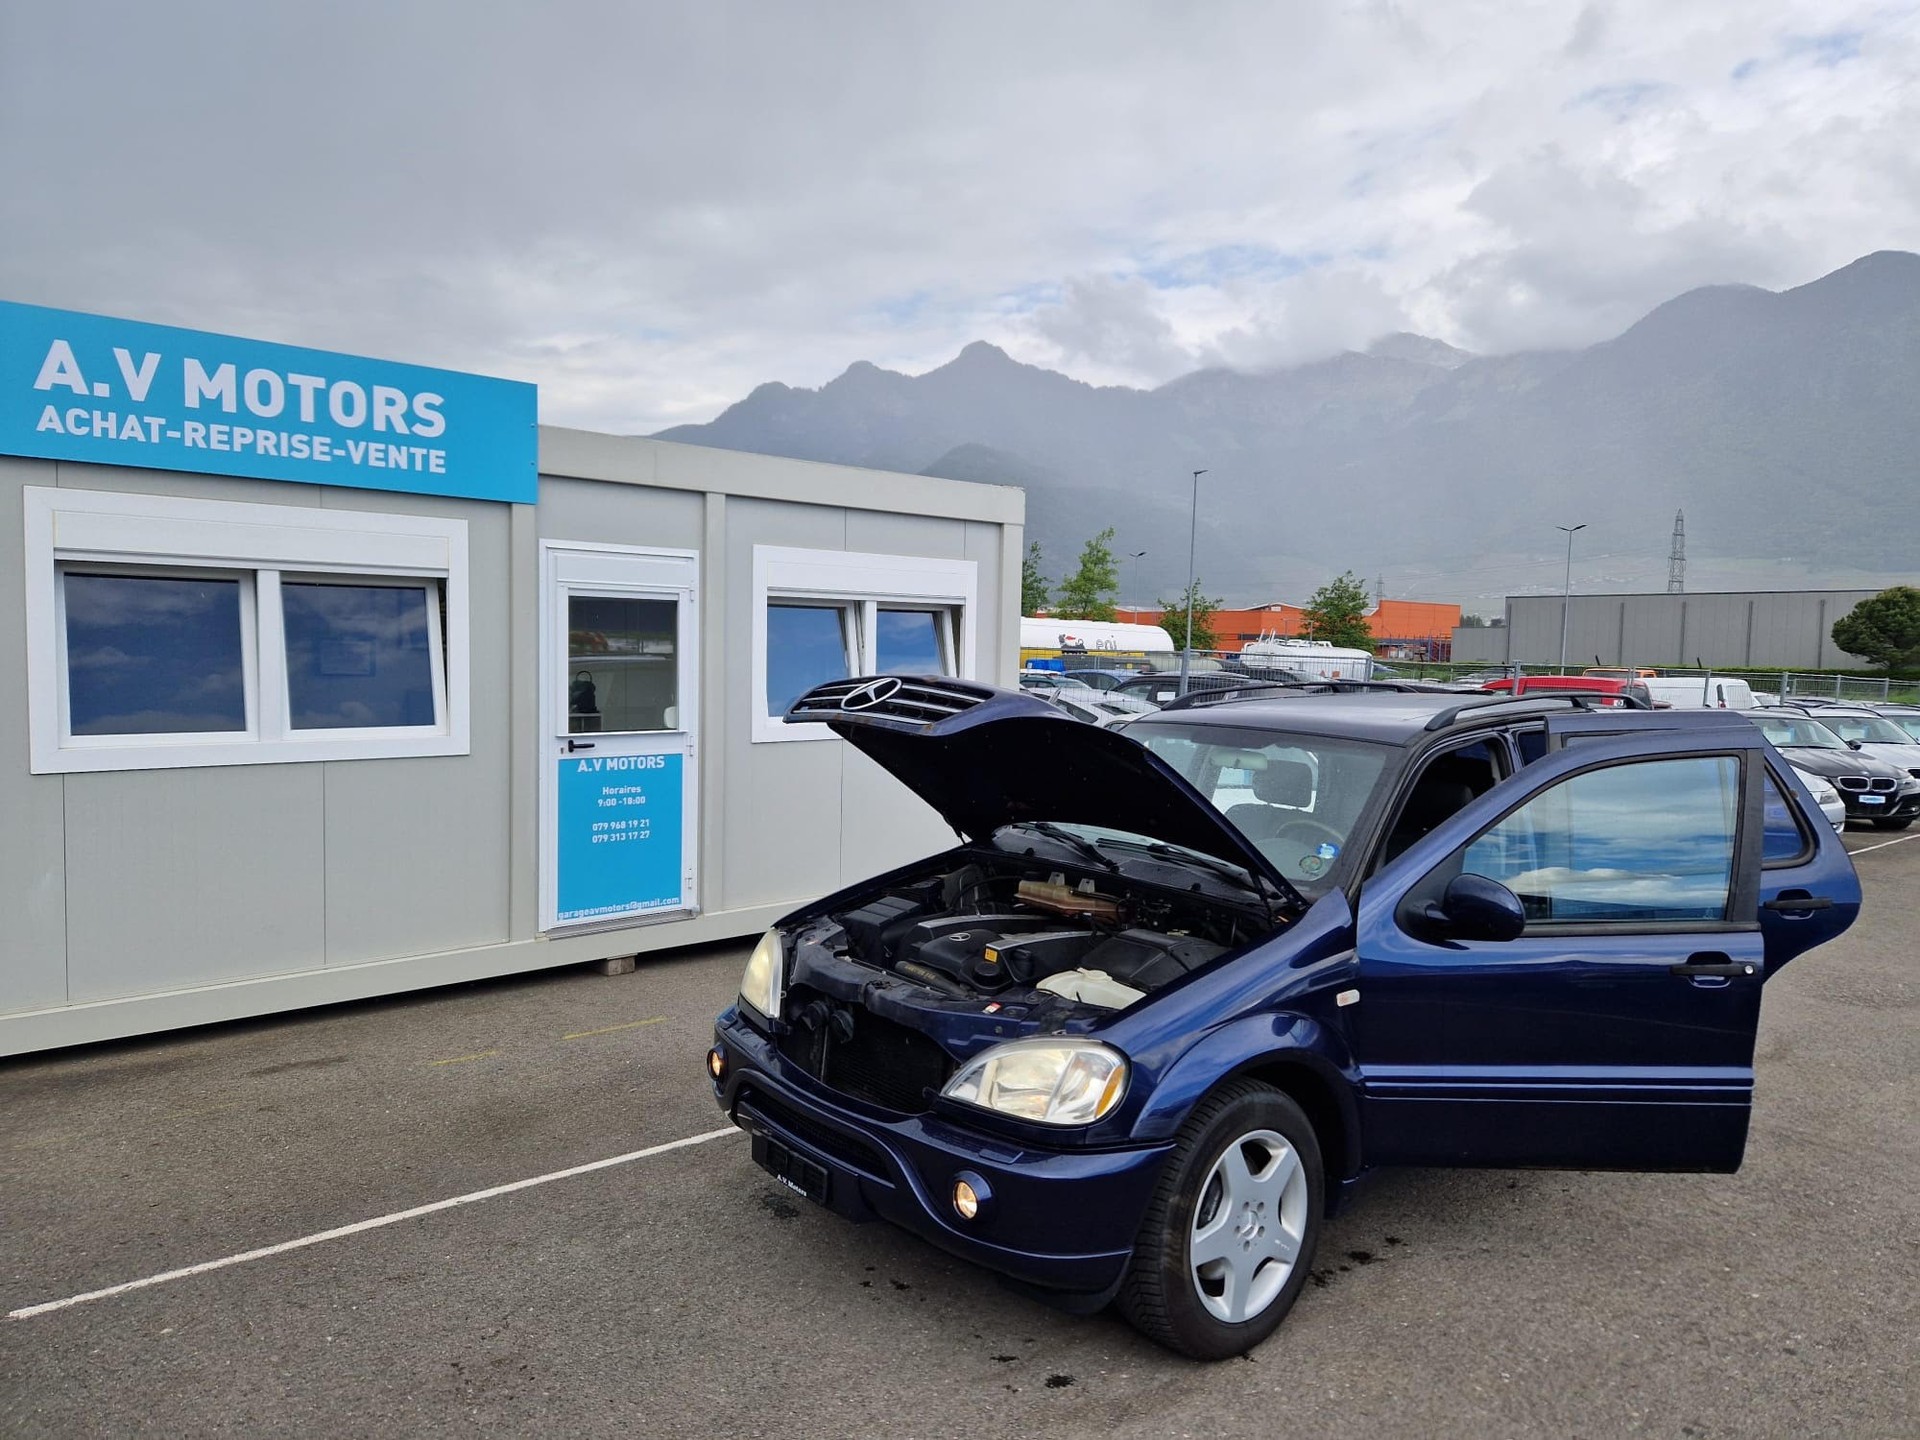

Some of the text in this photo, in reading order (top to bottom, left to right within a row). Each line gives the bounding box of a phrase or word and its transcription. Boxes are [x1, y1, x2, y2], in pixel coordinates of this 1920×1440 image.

[33, 339, 446, 438] A.V MOTORS
[36, 404, 446, 474] ACHAT-REPRISE-VENTE
[577, 756, 665, 773] A.V MOTORS
[602, 785, 641, 795] Horaires
[597, 798, 617, 807] 9:00
[592, 819, 650, 831] 079 968 19 21
[592, 830, 650, 843] 079 313 17 27
[558, 896, 680, 919] garageavmotors@gmail.com
